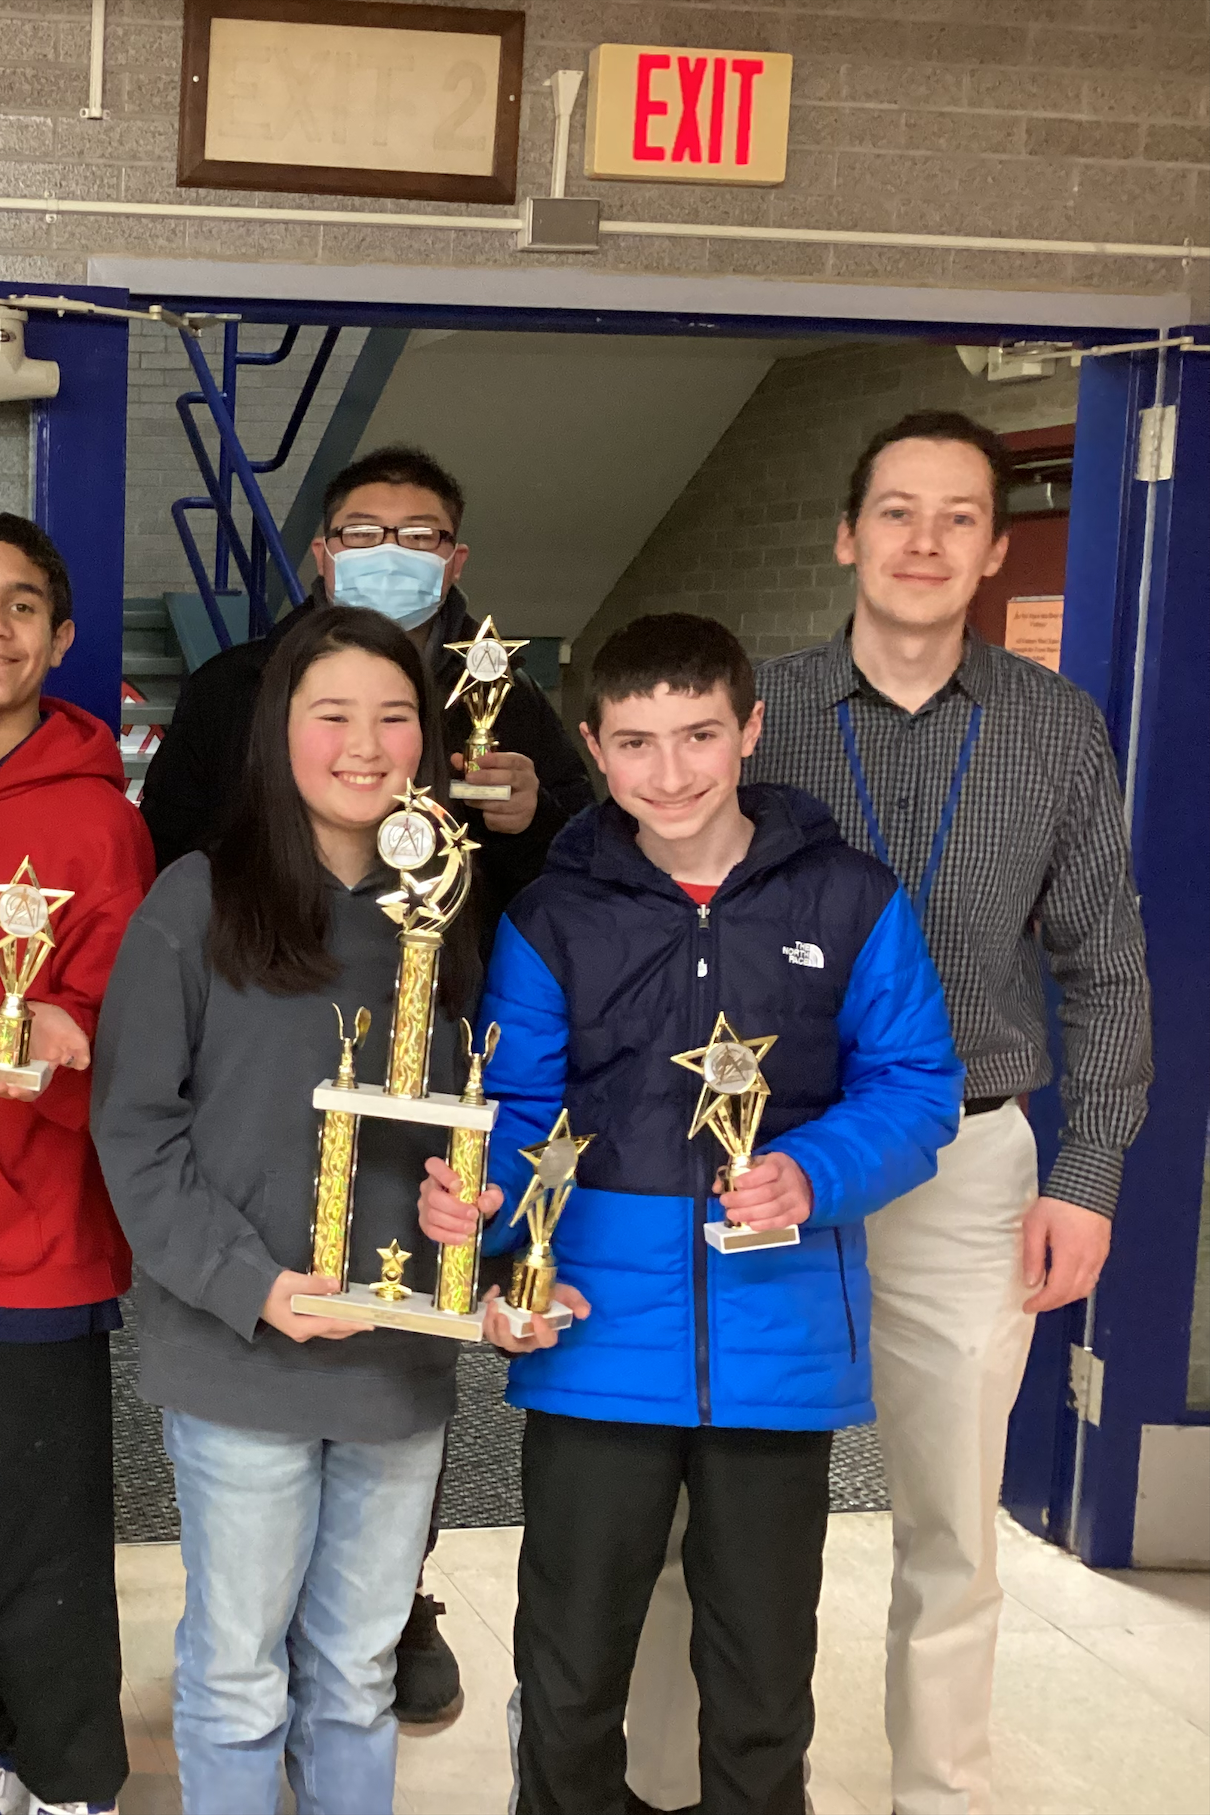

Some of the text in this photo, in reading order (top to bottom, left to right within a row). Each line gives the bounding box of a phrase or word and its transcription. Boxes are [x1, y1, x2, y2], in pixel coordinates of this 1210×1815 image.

[218, 44, 488, 152] EXIT 2
[632, 53, 764, 165] EXIT
[782, 945, 810, 959] NORTH
[795, 940, 811, 951] THE
[788, 955, 810, 966] FACE
